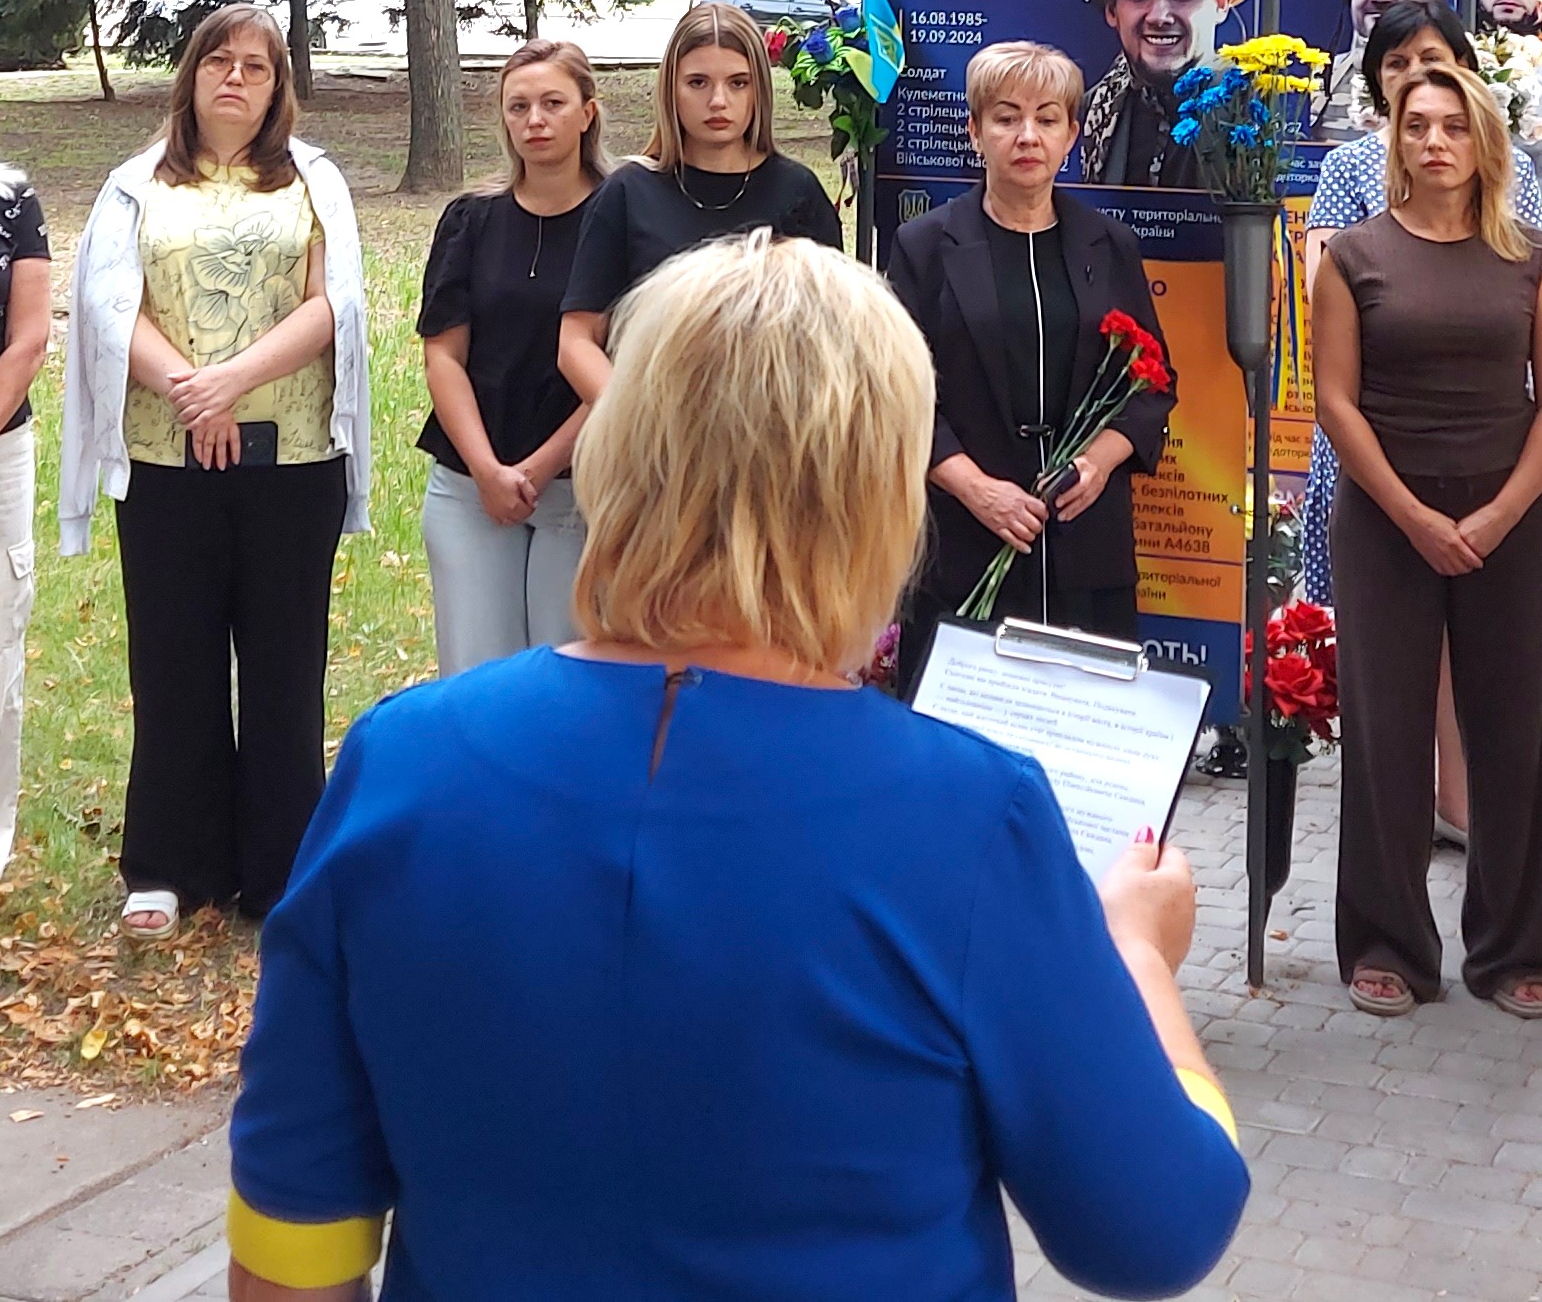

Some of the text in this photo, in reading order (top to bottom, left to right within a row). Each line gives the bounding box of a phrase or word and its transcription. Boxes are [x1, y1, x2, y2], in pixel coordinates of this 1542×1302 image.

[911, 12, 987, 26] 16.08.1985-
[911, 30, 982, 44] 19.09.2024
[897, 86, 967, 102] Кулеметни
[897, 103, 905, 115] 2
[897, 119, 905, 132] 2
[896, 135, 904, 148] 2
[896, 152, 988, 168] Військової час
[1141, 484, 1228, 503] безпілотних
[1164, 538, 1210, 554] А4638
